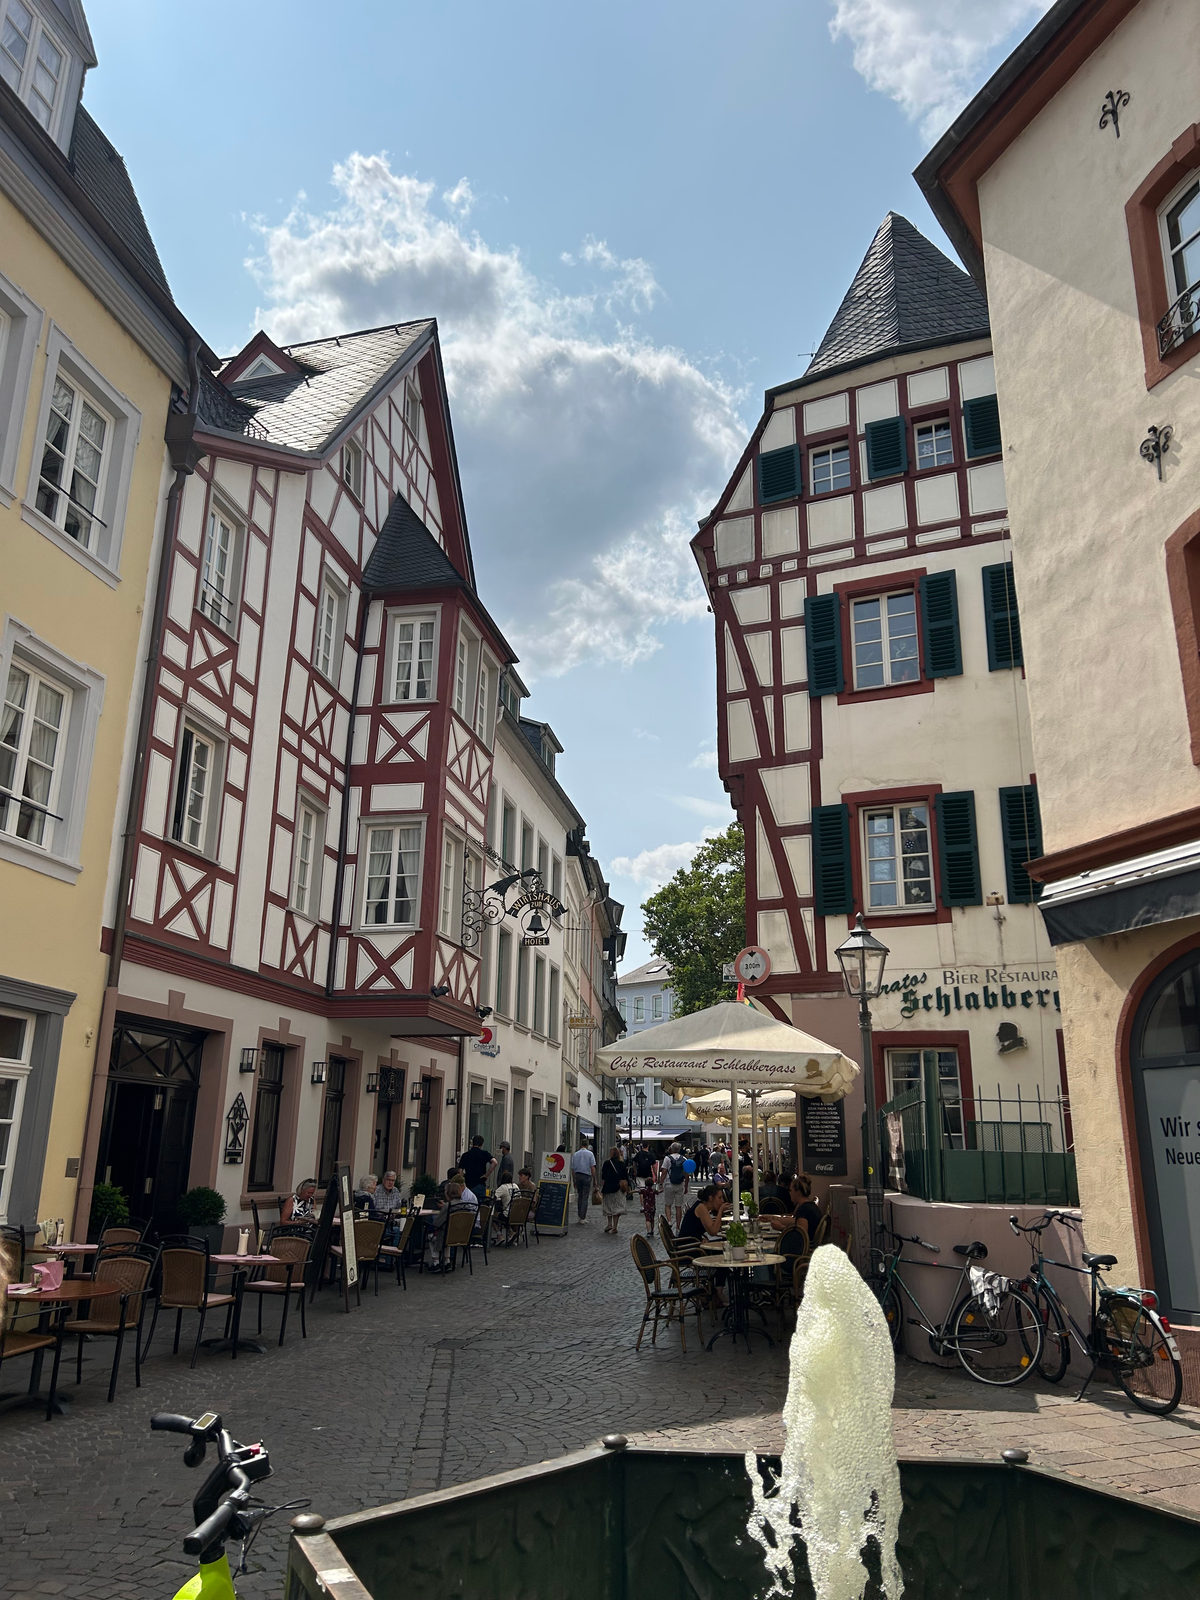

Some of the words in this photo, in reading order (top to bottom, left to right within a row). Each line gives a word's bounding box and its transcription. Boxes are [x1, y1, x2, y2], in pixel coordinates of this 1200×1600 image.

[513, 891, 561, 910] WIRTSHAUS
[524, 938, 546, 946] HOTEL
[878, 972, 927, 995] ratos
[642, 1056, 708, 1069] Restaurant
[711, 1058, 796, 1077] Schlabbergass
[624, 1115, 661, 1126] KEMPE
[1160, 1115, 1191, 1137] Wir
[1165, 1147, 1200, 1165] Neue
